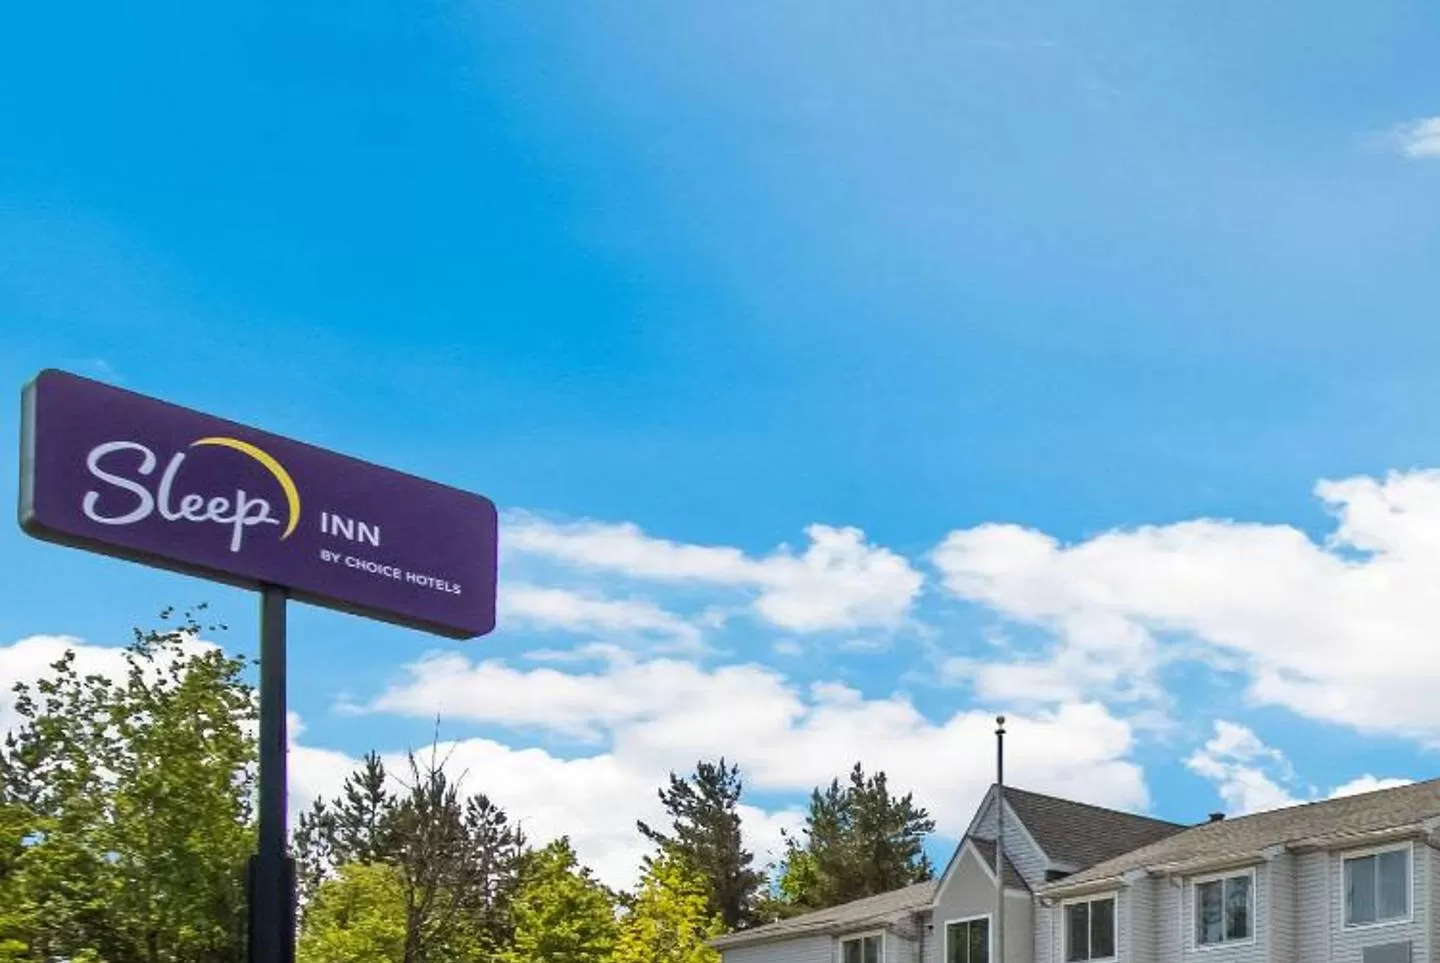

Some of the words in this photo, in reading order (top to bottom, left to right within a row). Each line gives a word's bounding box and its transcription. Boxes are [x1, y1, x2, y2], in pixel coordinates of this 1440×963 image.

[83, 440, 279, 552] Sleep
[321, 511, 380, 547] INN
[320, 549, 341, 563] BY
[344, 556, 401, 580] CHOICE
[406, 571, 462, 594] HOTELS
